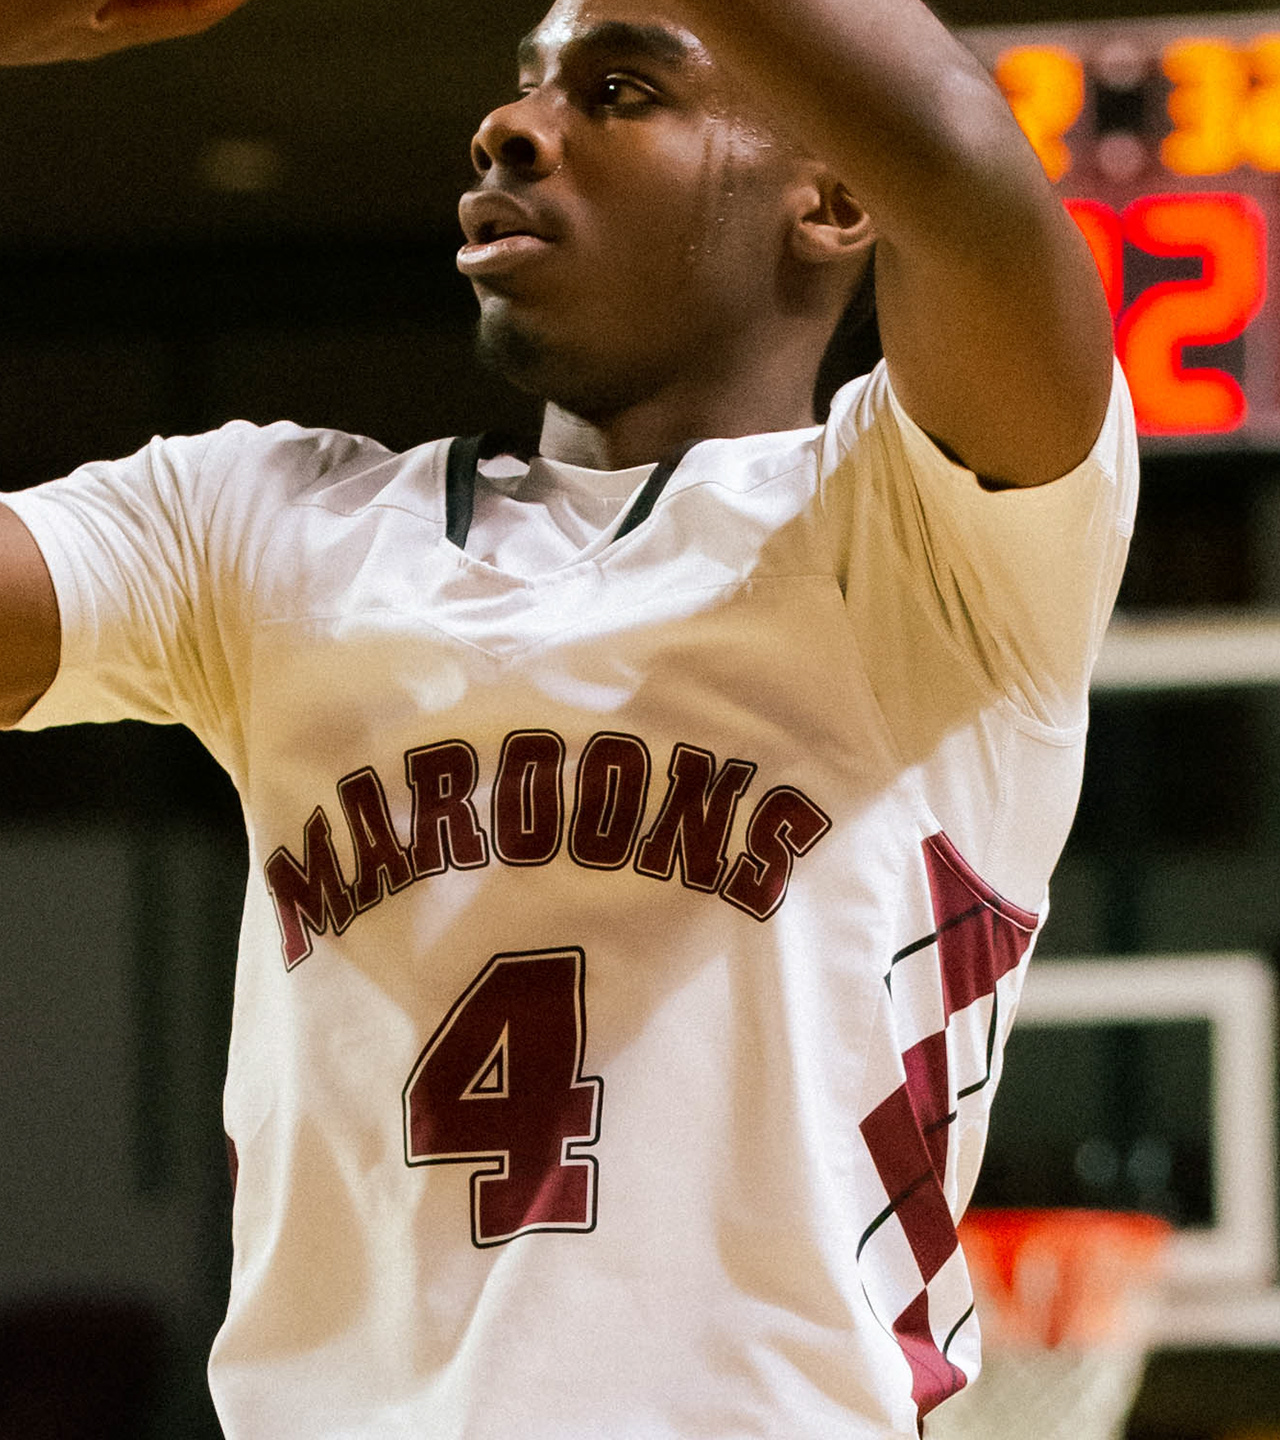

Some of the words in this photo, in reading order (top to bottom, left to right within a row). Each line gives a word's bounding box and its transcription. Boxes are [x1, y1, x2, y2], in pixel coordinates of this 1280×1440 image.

[1060, 192, 1268, 436] 2
[264, 728, 832, 972] MAROONS
[403, 945, 604, 1249] 4
